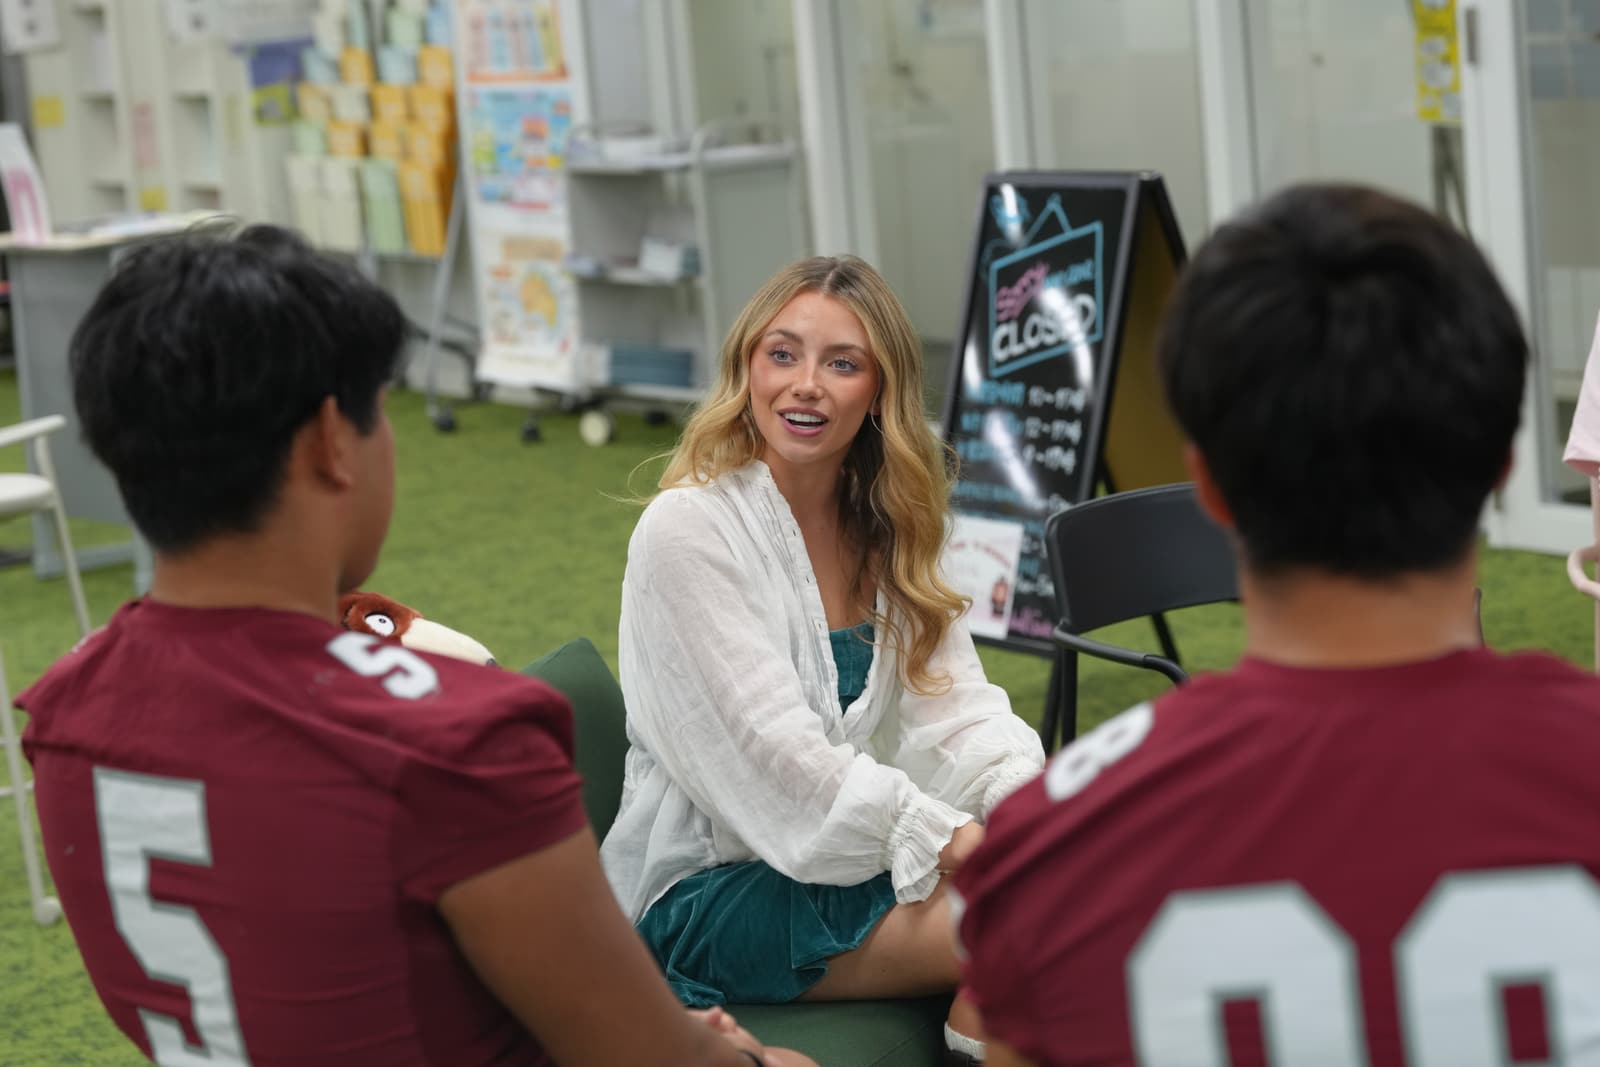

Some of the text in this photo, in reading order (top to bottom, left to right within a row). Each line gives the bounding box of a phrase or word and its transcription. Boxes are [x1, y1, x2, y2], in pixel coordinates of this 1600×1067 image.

[992, 294, 1097, 362] CLOSD
[325, 631, 440, 700] 5
[1044, 700, 1155, 803] 8
[92, 765, 253, 1067] 5
